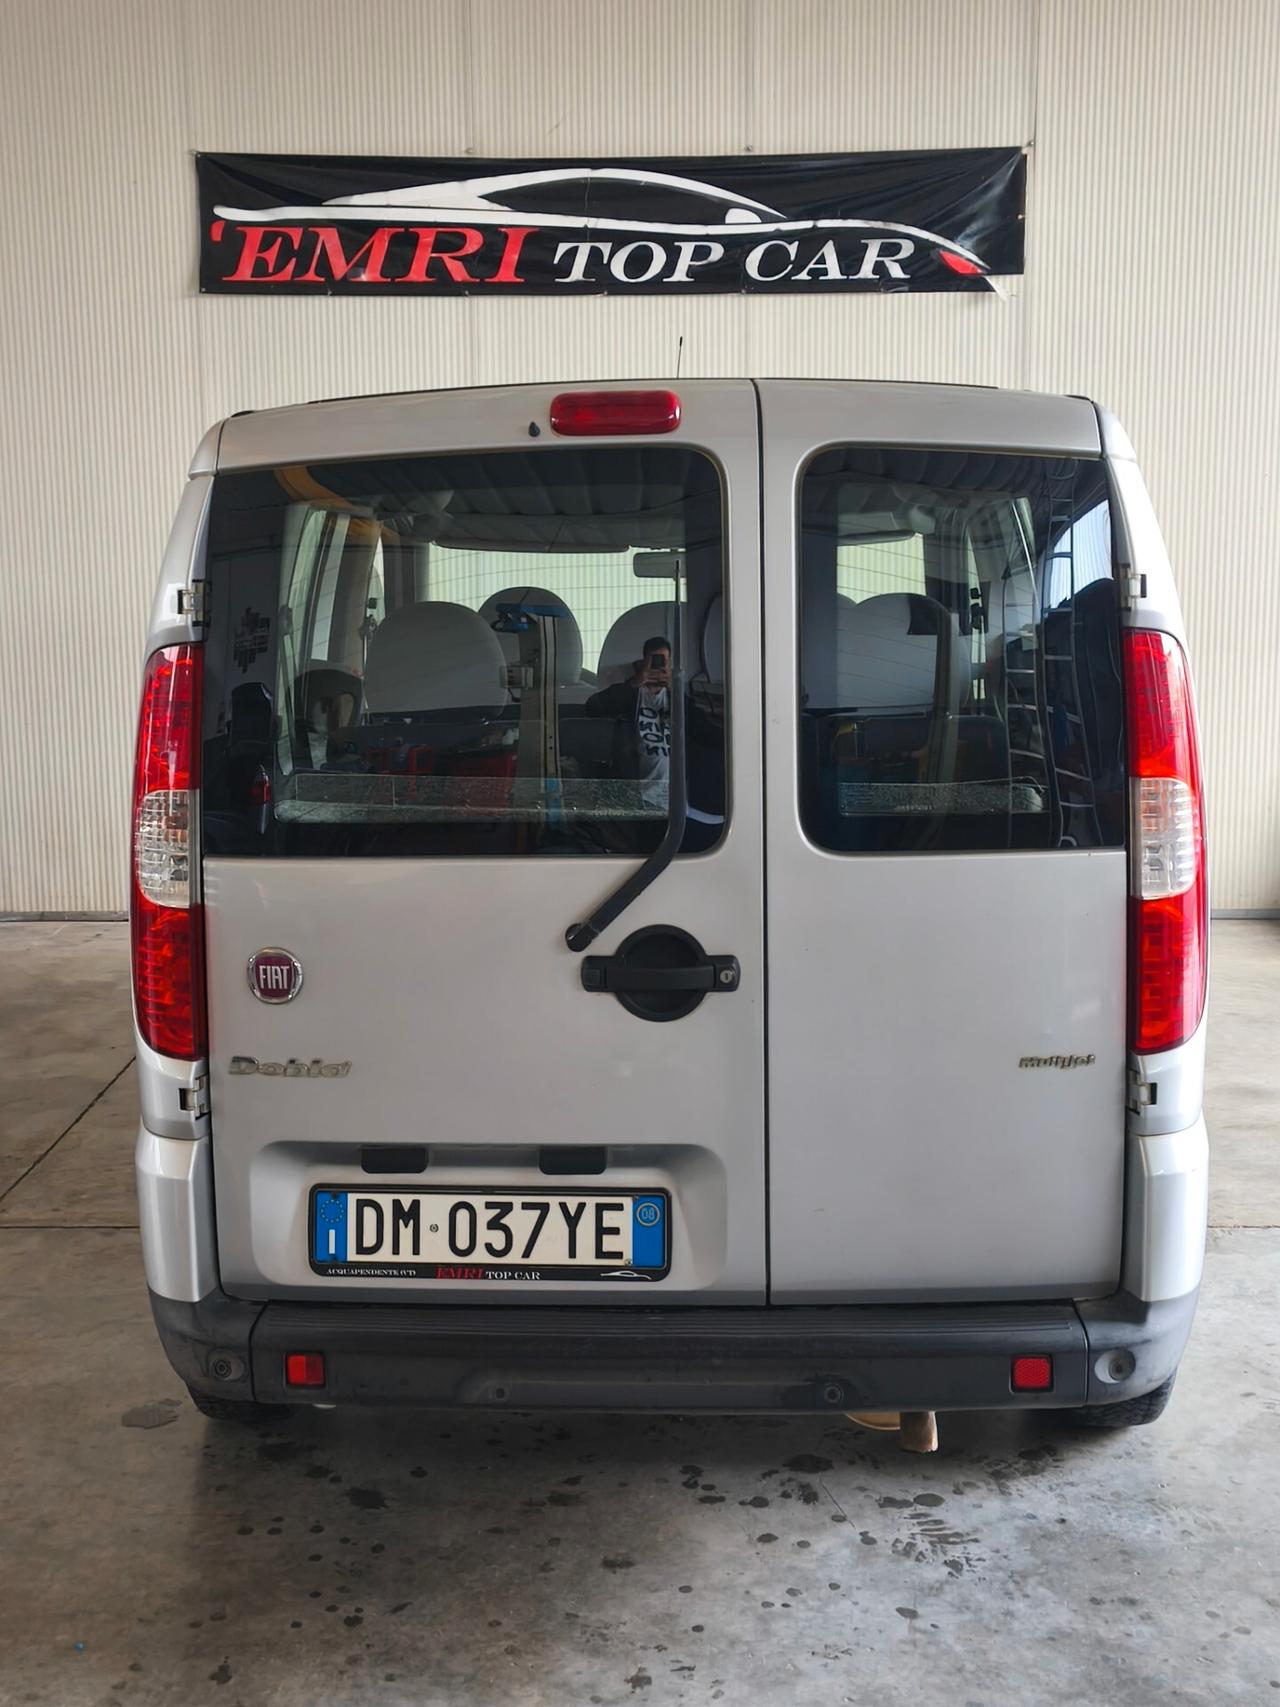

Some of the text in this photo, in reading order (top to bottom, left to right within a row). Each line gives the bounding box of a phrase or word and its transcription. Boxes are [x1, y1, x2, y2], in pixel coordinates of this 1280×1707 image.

[221, 226, 915, 283] EMRI TOP CAR
[258, 965, 290, 990] FIAT
[355, 1198, 626, 1260] DM 037YE
[435, 1266, 541, 1280] EMRI TOP CAR
